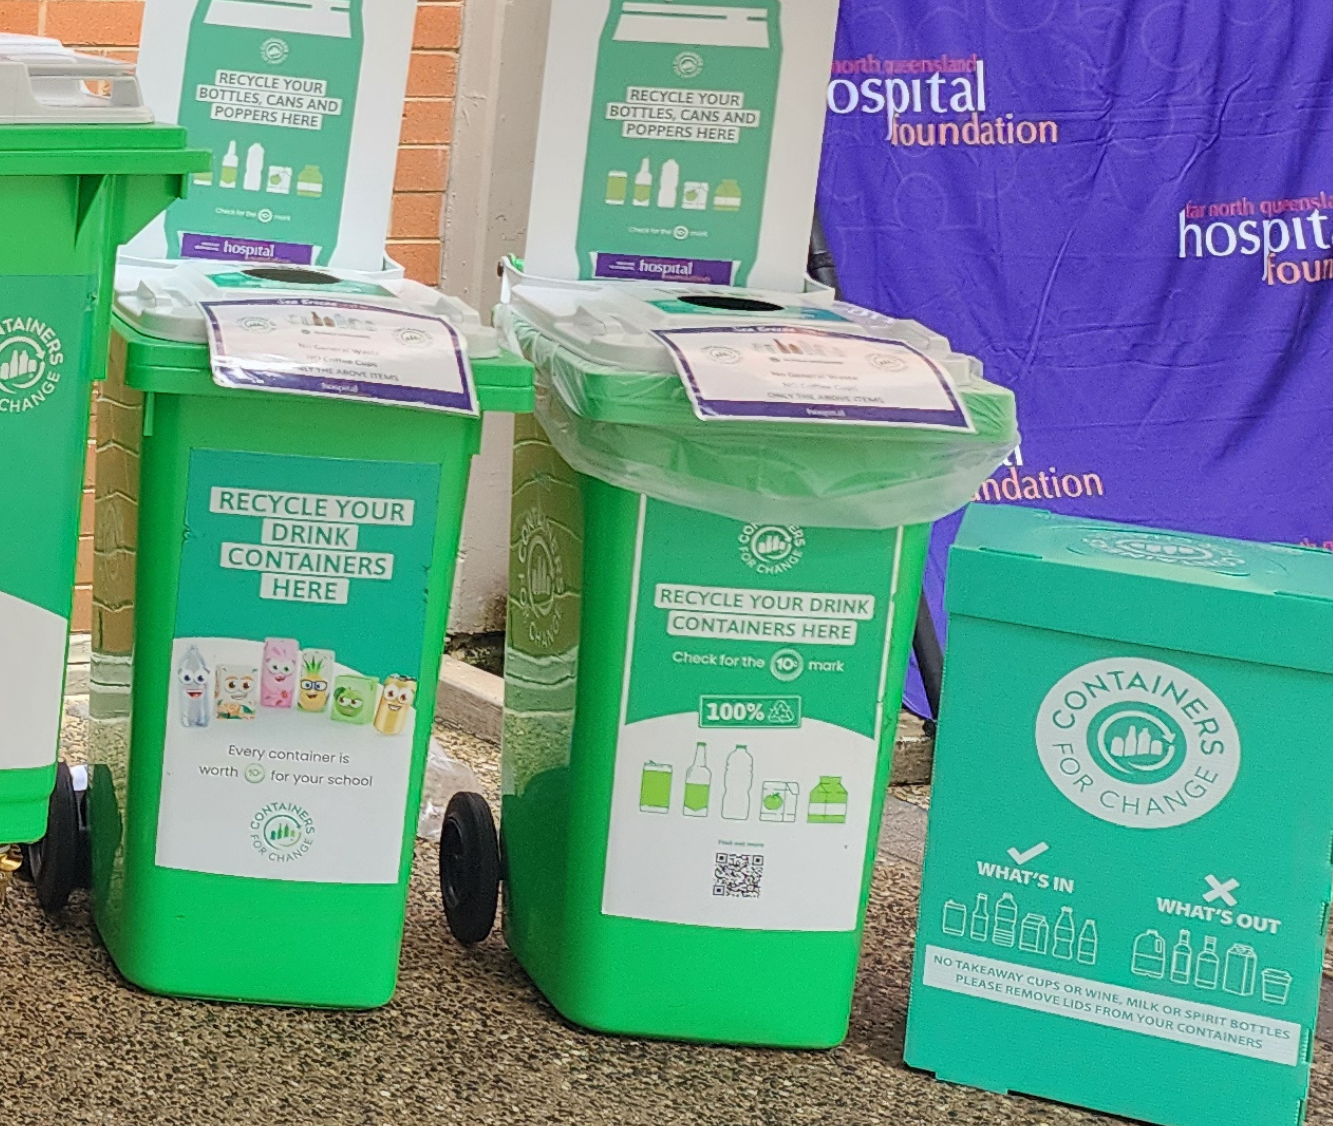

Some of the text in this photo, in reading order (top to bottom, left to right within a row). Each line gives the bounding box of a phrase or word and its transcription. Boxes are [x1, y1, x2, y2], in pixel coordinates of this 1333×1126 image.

[219, 72, 323, 94] RECYCLE YOUR
[199, 88, 338, 112] BOTTLES, CANS AND
[629, 89, 740, 106] RECYCLE YOUR
[827, 60, 986, 140] ospital
[215, 106, 319, 128] POPPERS HERE
[609, 106, 755, 124] BOTTLES, CANS AND
[626, 124, 735, 141] POPPERS HERE
[891, 112, 1058, 146] foundation
[1186, 200, 1206, 218] far
[1209, 197, 1255, 216] north
[223, 240, 275, 258] hospital
[1179, 208, 1333, 281] hospit
[639, 259, 693, 278] hospital
[969, 467, 1105, 502] ndation
[219, 491, 405, 522] RECYCLE YOUR
[271, 523, 349, 546] DRINK
[228, 548, 387, 576] CONTAINERS
[738, 546, 803, 574] FOR CHANGE
[272, 578, 338, 601] HERE
[660, 589, 869, 615] RECYCLE YOUR DRINK
[673, 616, 852, 640] CONTAINERS HERE
[672, 651, 845, 672] Check for the mark
[706, 702, 765, 722] 100%
[1052, 670, 1225, 756] CONTAINERS
[228, 744, 350, 764] Every container is
[199, 764, 373, 787] worth for your school
[1052, 742, 1219, 816] FOR CHANGE
[250, 802, 315, 835] CONTAINERS
[250, 834, 313, 862] FOR CHANGE
[976, 860, 1075, 894] WHAT'S IN
[1156, 897, 1282, 935] WHAT'S OUT
[933, 954, 1291, 1040] NO TAKEAWAY CUPS OR WINE, MILK OR SPIRIT BOTTLES
[955, 974, 1263, 1050] PLEASE REMOVE LIDS FROM YOUR CONTAINERS
